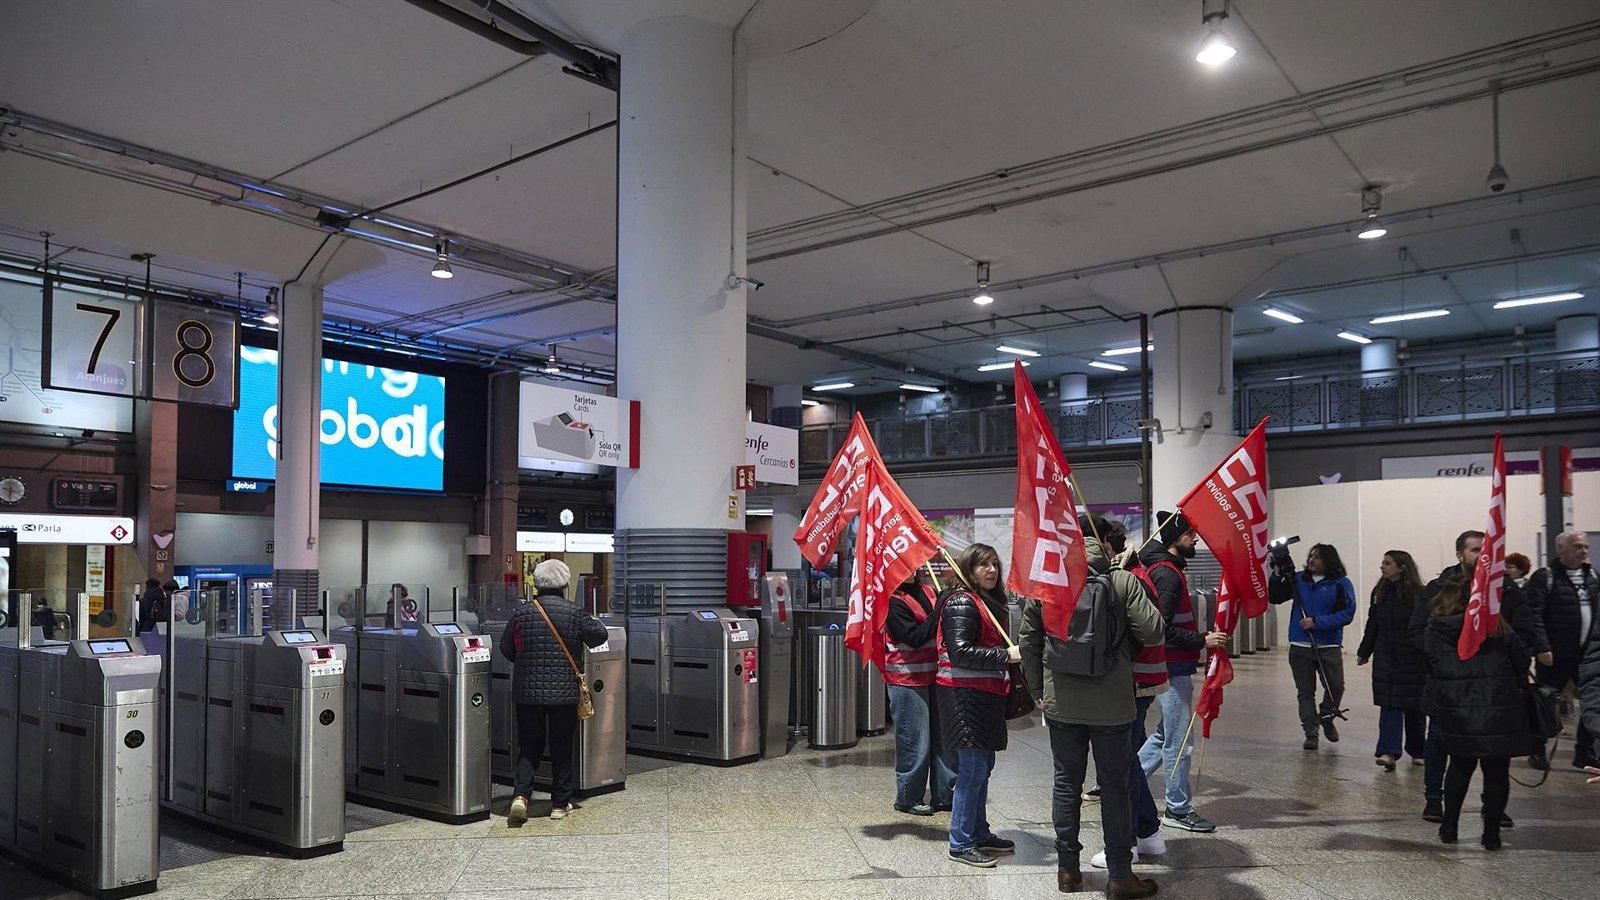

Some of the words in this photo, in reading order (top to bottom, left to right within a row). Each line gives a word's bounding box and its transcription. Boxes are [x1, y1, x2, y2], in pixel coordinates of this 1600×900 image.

[76, 303, 121, 375] 7
[172, 320, 215, 388] 8
[77, 371, 125, 386] Aranjuez
[574, 394, 597, 406] Tarjetas
[573, 404, 590, 413] Cards
[612, 443, 622, 452] QR
[745, 434, 769, 455] enfe
[598, 450, 608, 458] QR
[1437, 463, 1485, 477] renfe
[233, 481, 257, 491] global
[1205, 478, 1232, 512] ervicios
[1228, 510, 1238, 520] a
[1234, 518, 1246, 532] la
[38, 524, 62, 533] Parla
[115, 527, 124, 538] 8
[126, 709, 139, 719] 30
